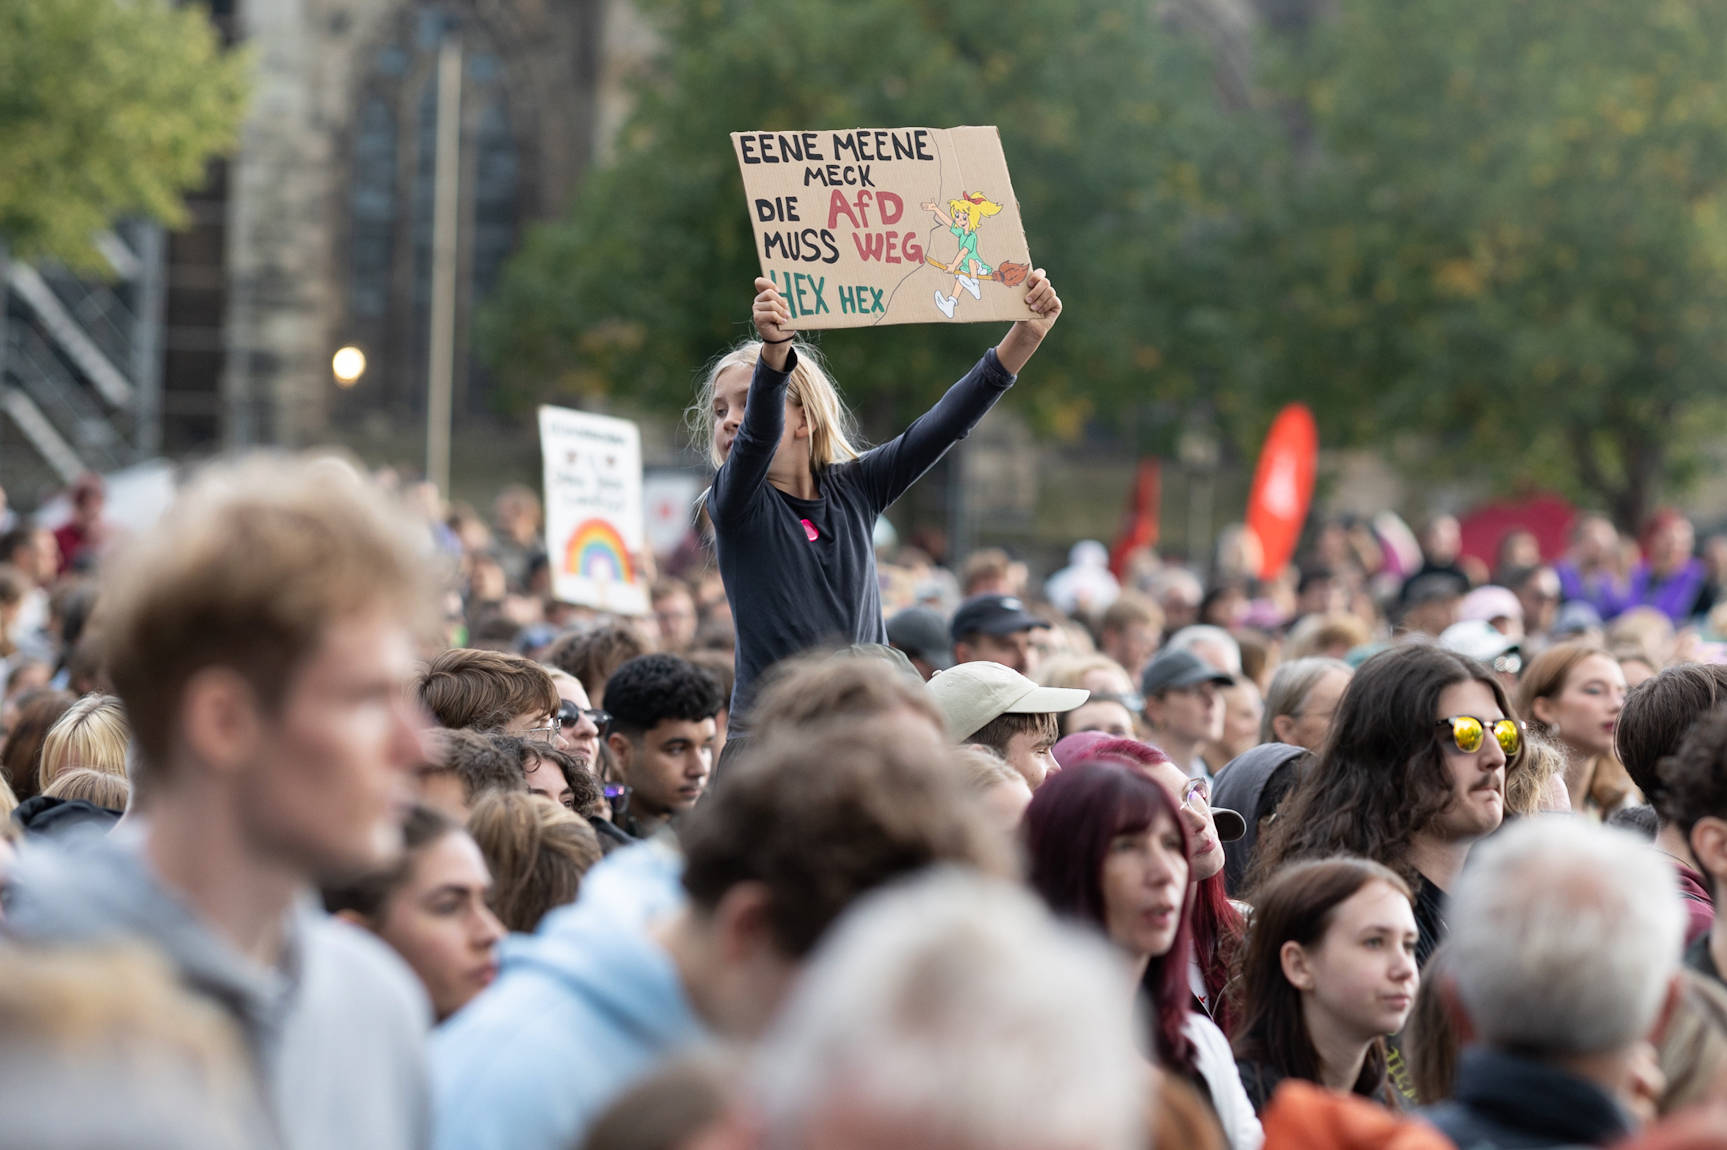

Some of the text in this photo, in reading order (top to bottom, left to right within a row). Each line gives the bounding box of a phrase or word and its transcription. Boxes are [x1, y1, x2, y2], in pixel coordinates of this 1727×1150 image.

[740, 130, 934, 164] EENE MEENE
[804, 164, 875, 187] MECK
[755, 189, 903, 229] DIE AfD
[764, 229, 925, 264] MUSS WEG
[770, 270, 885, 319] HEX HEX
